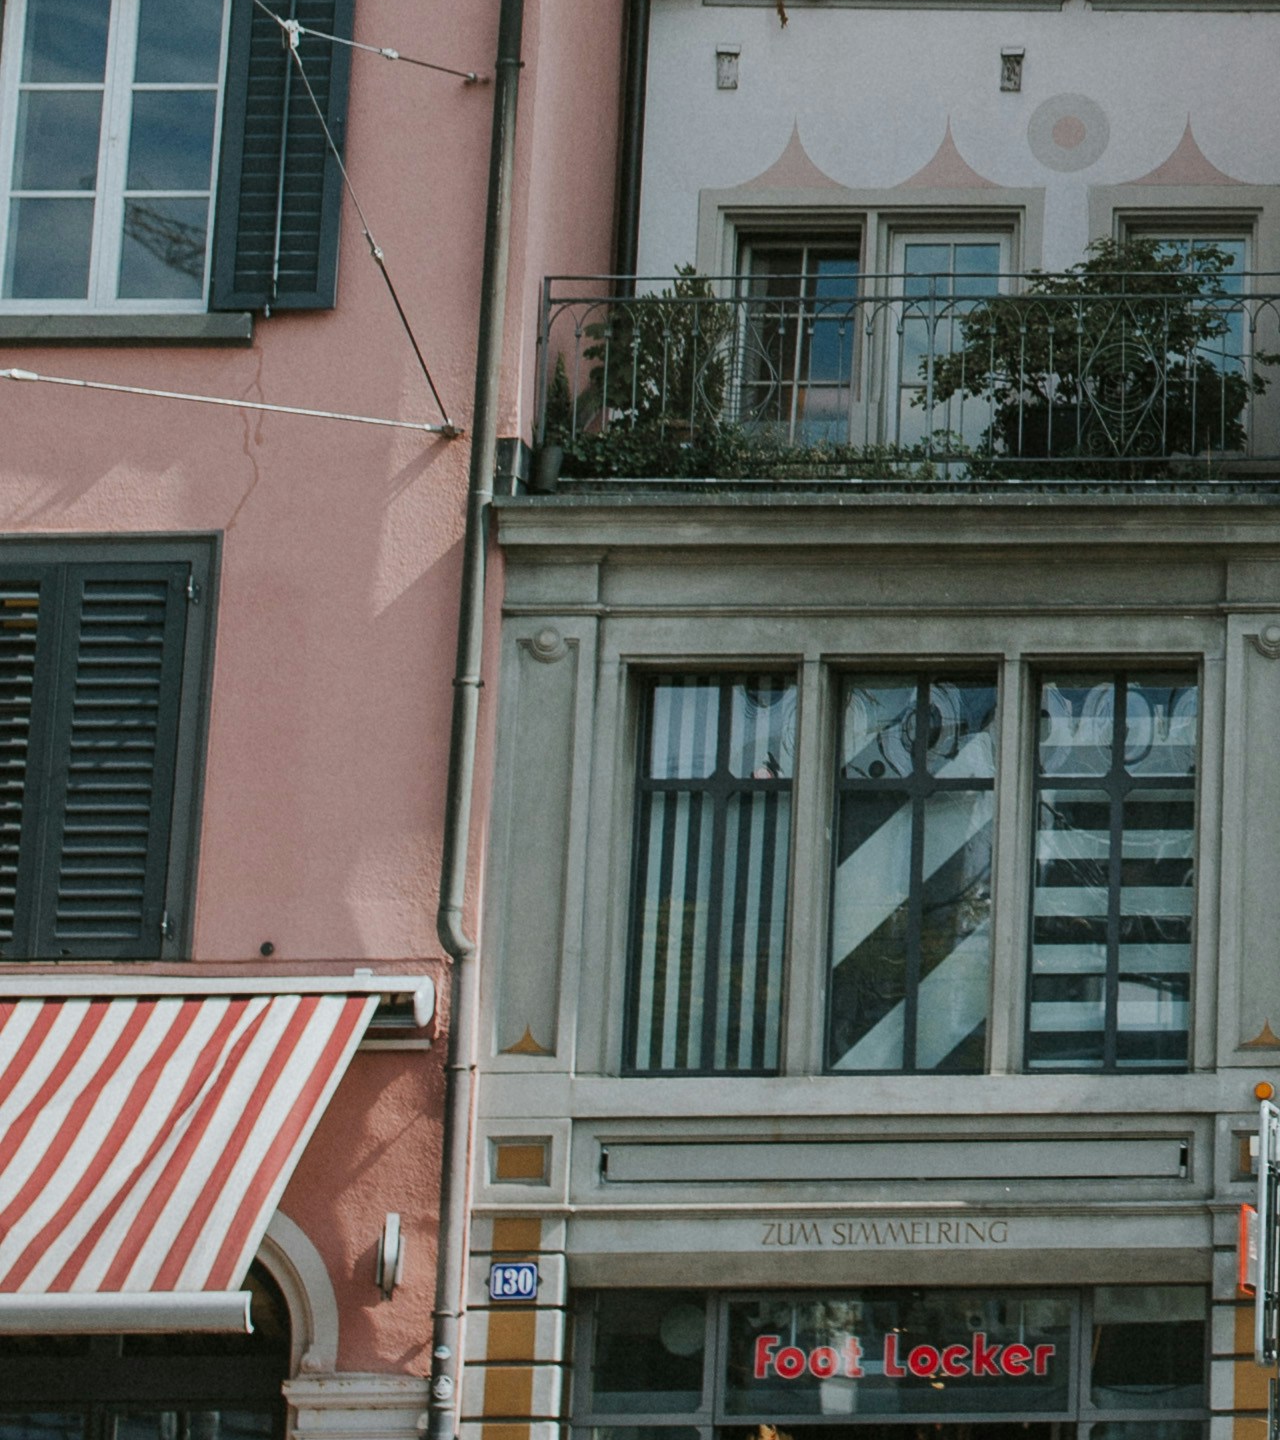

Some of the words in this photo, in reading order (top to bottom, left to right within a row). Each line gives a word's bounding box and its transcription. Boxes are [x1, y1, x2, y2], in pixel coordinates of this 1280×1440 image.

[761, 1221, 823, 1246] ZUM
[831, 1220, 1009, 1246] SIMMELRING
[494, 1267, 533, 1295] 130
[753, 1333, 865, 1379] Foot
[882, 1331, 1056, 1378] Locker
